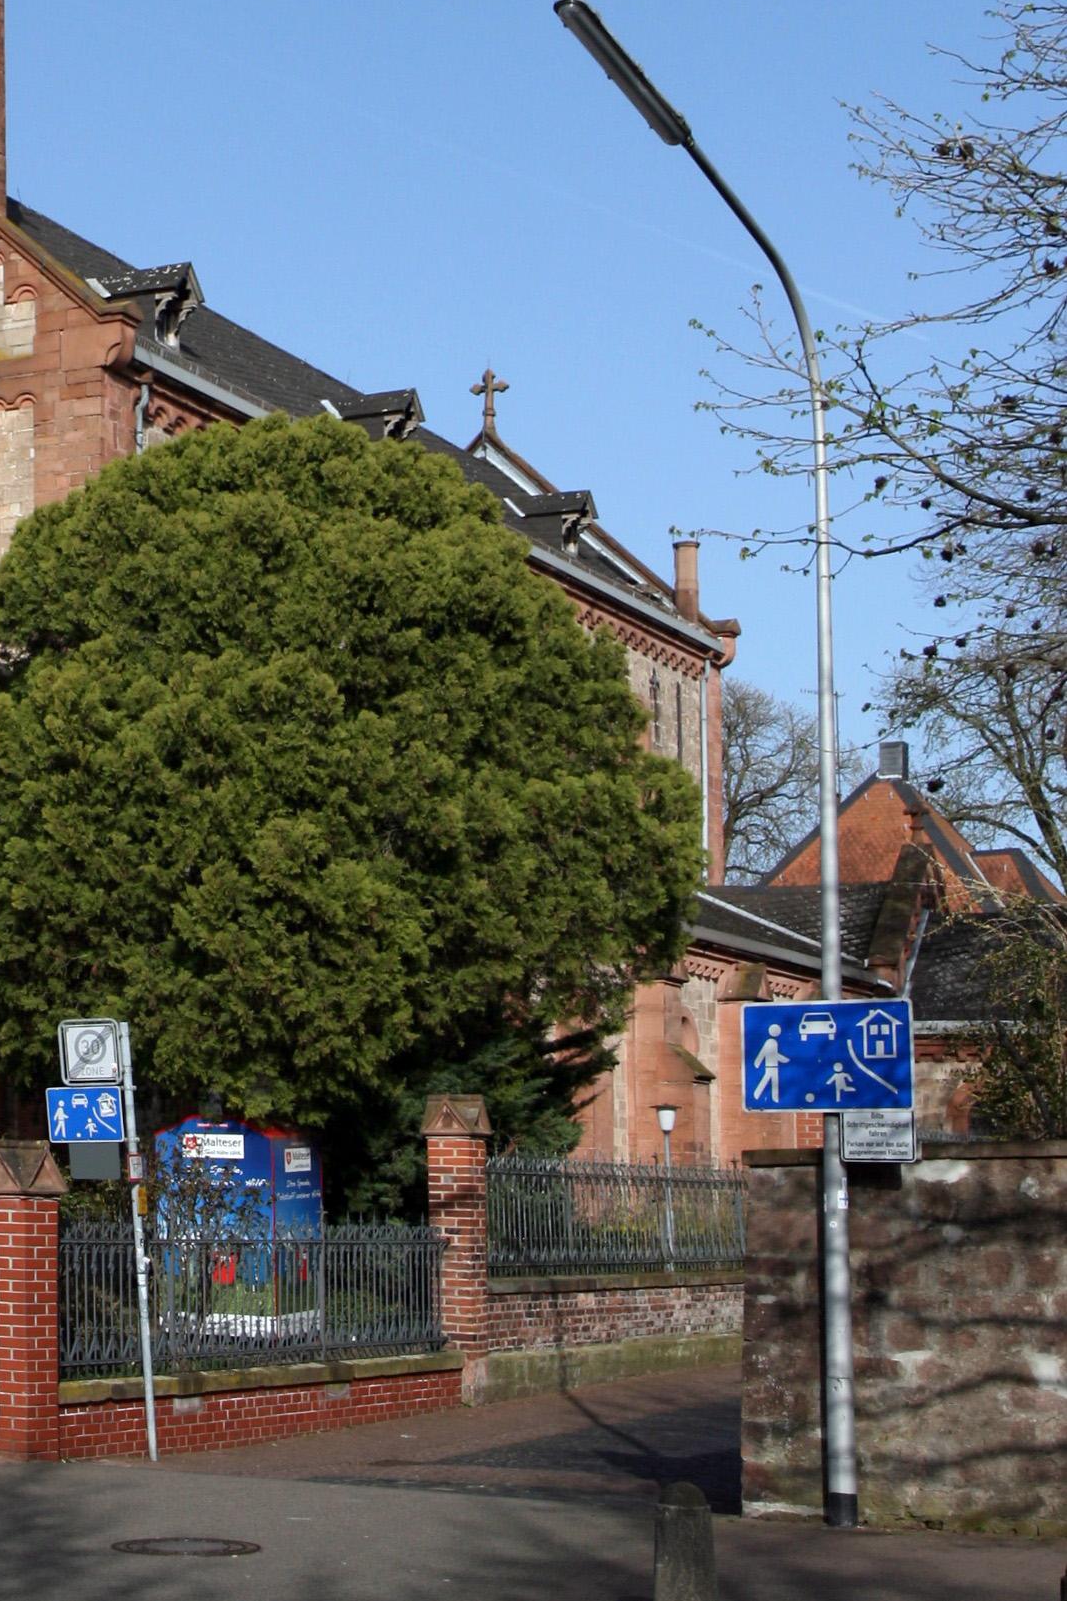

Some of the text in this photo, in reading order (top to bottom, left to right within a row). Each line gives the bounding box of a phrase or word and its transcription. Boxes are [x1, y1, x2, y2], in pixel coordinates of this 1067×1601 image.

[80, 1038, 101, 1055] 30
[82, 1066, 105, 1076] ZONE
[846, 1120, 910, 1129] Schrittgeschwindigkeit
[201, 1137, 241, 1147] Malteser
